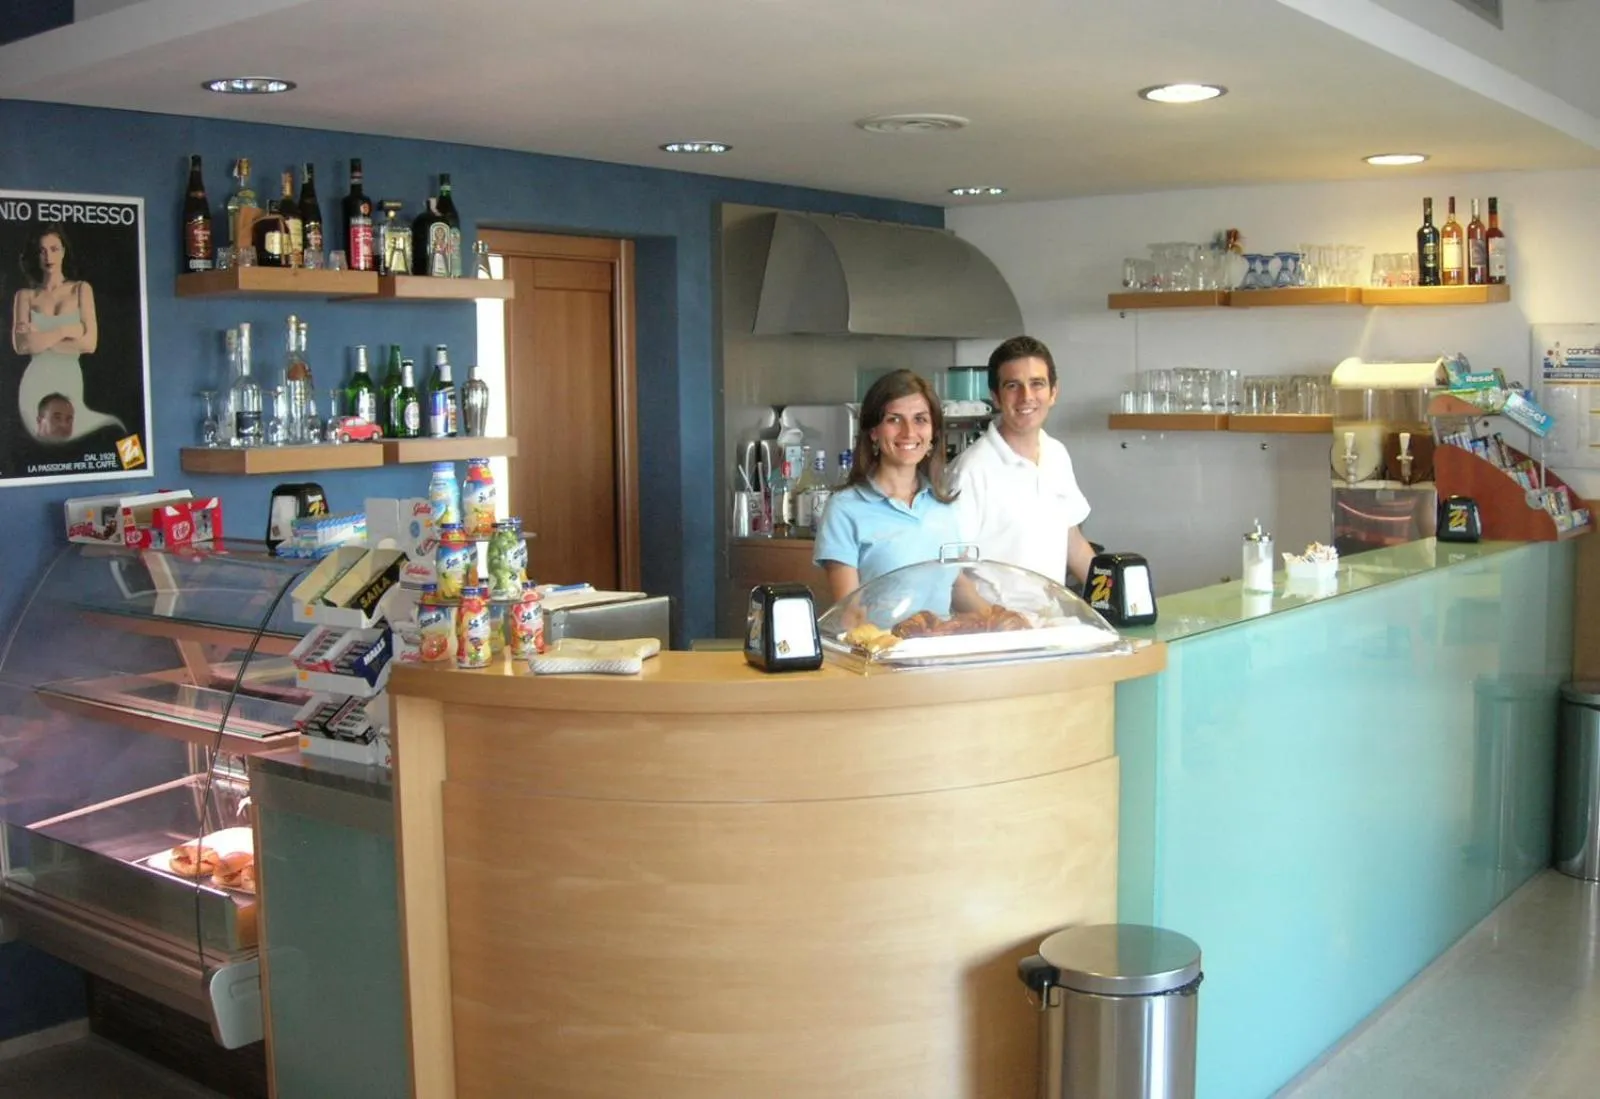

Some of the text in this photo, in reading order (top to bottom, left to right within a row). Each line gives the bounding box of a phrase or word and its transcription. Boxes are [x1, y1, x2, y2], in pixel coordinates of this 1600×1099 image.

[38, 203, 135, 225] ESPRESSO
[1466, 374, 1495, 382] Reset
[84, 453, 98, 462] DAL
[27, 465, 37, 473] LA
[38, 463, 73, 472] PASSIONE
[74, 461, 87, 470] PER
[360, 577, 391, 609] SAILA
[363, 638, 386, 666] HALLS
